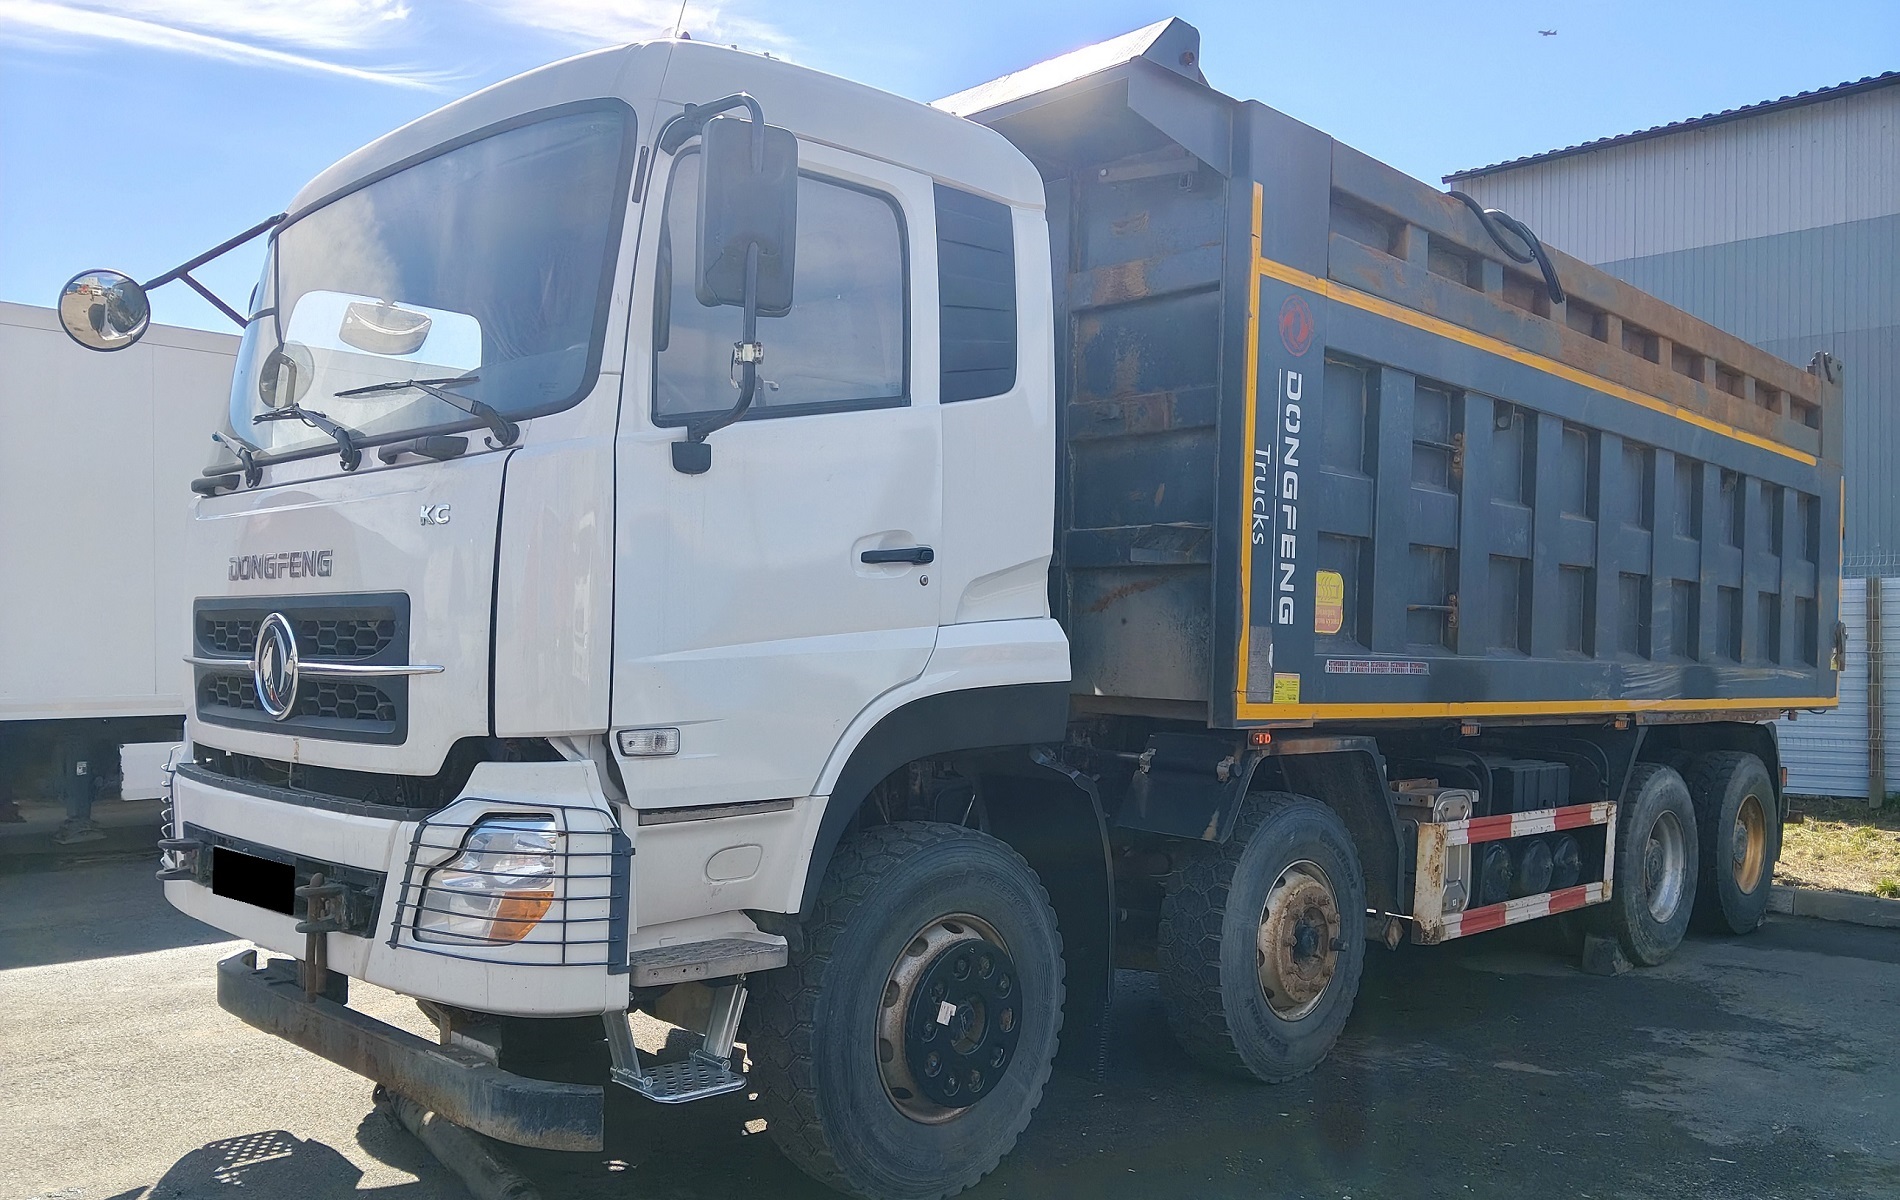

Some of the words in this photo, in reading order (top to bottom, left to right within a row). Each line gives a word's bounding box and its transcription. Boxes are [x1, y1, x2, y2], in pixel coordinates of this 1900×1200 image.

[420, 504, 451, 526] KC
[1252, 444, 1271, 545] Trucks
[1279, 370, 1303, 625] DONGFENG
[228, 549, 333, 581] DONGFENG
